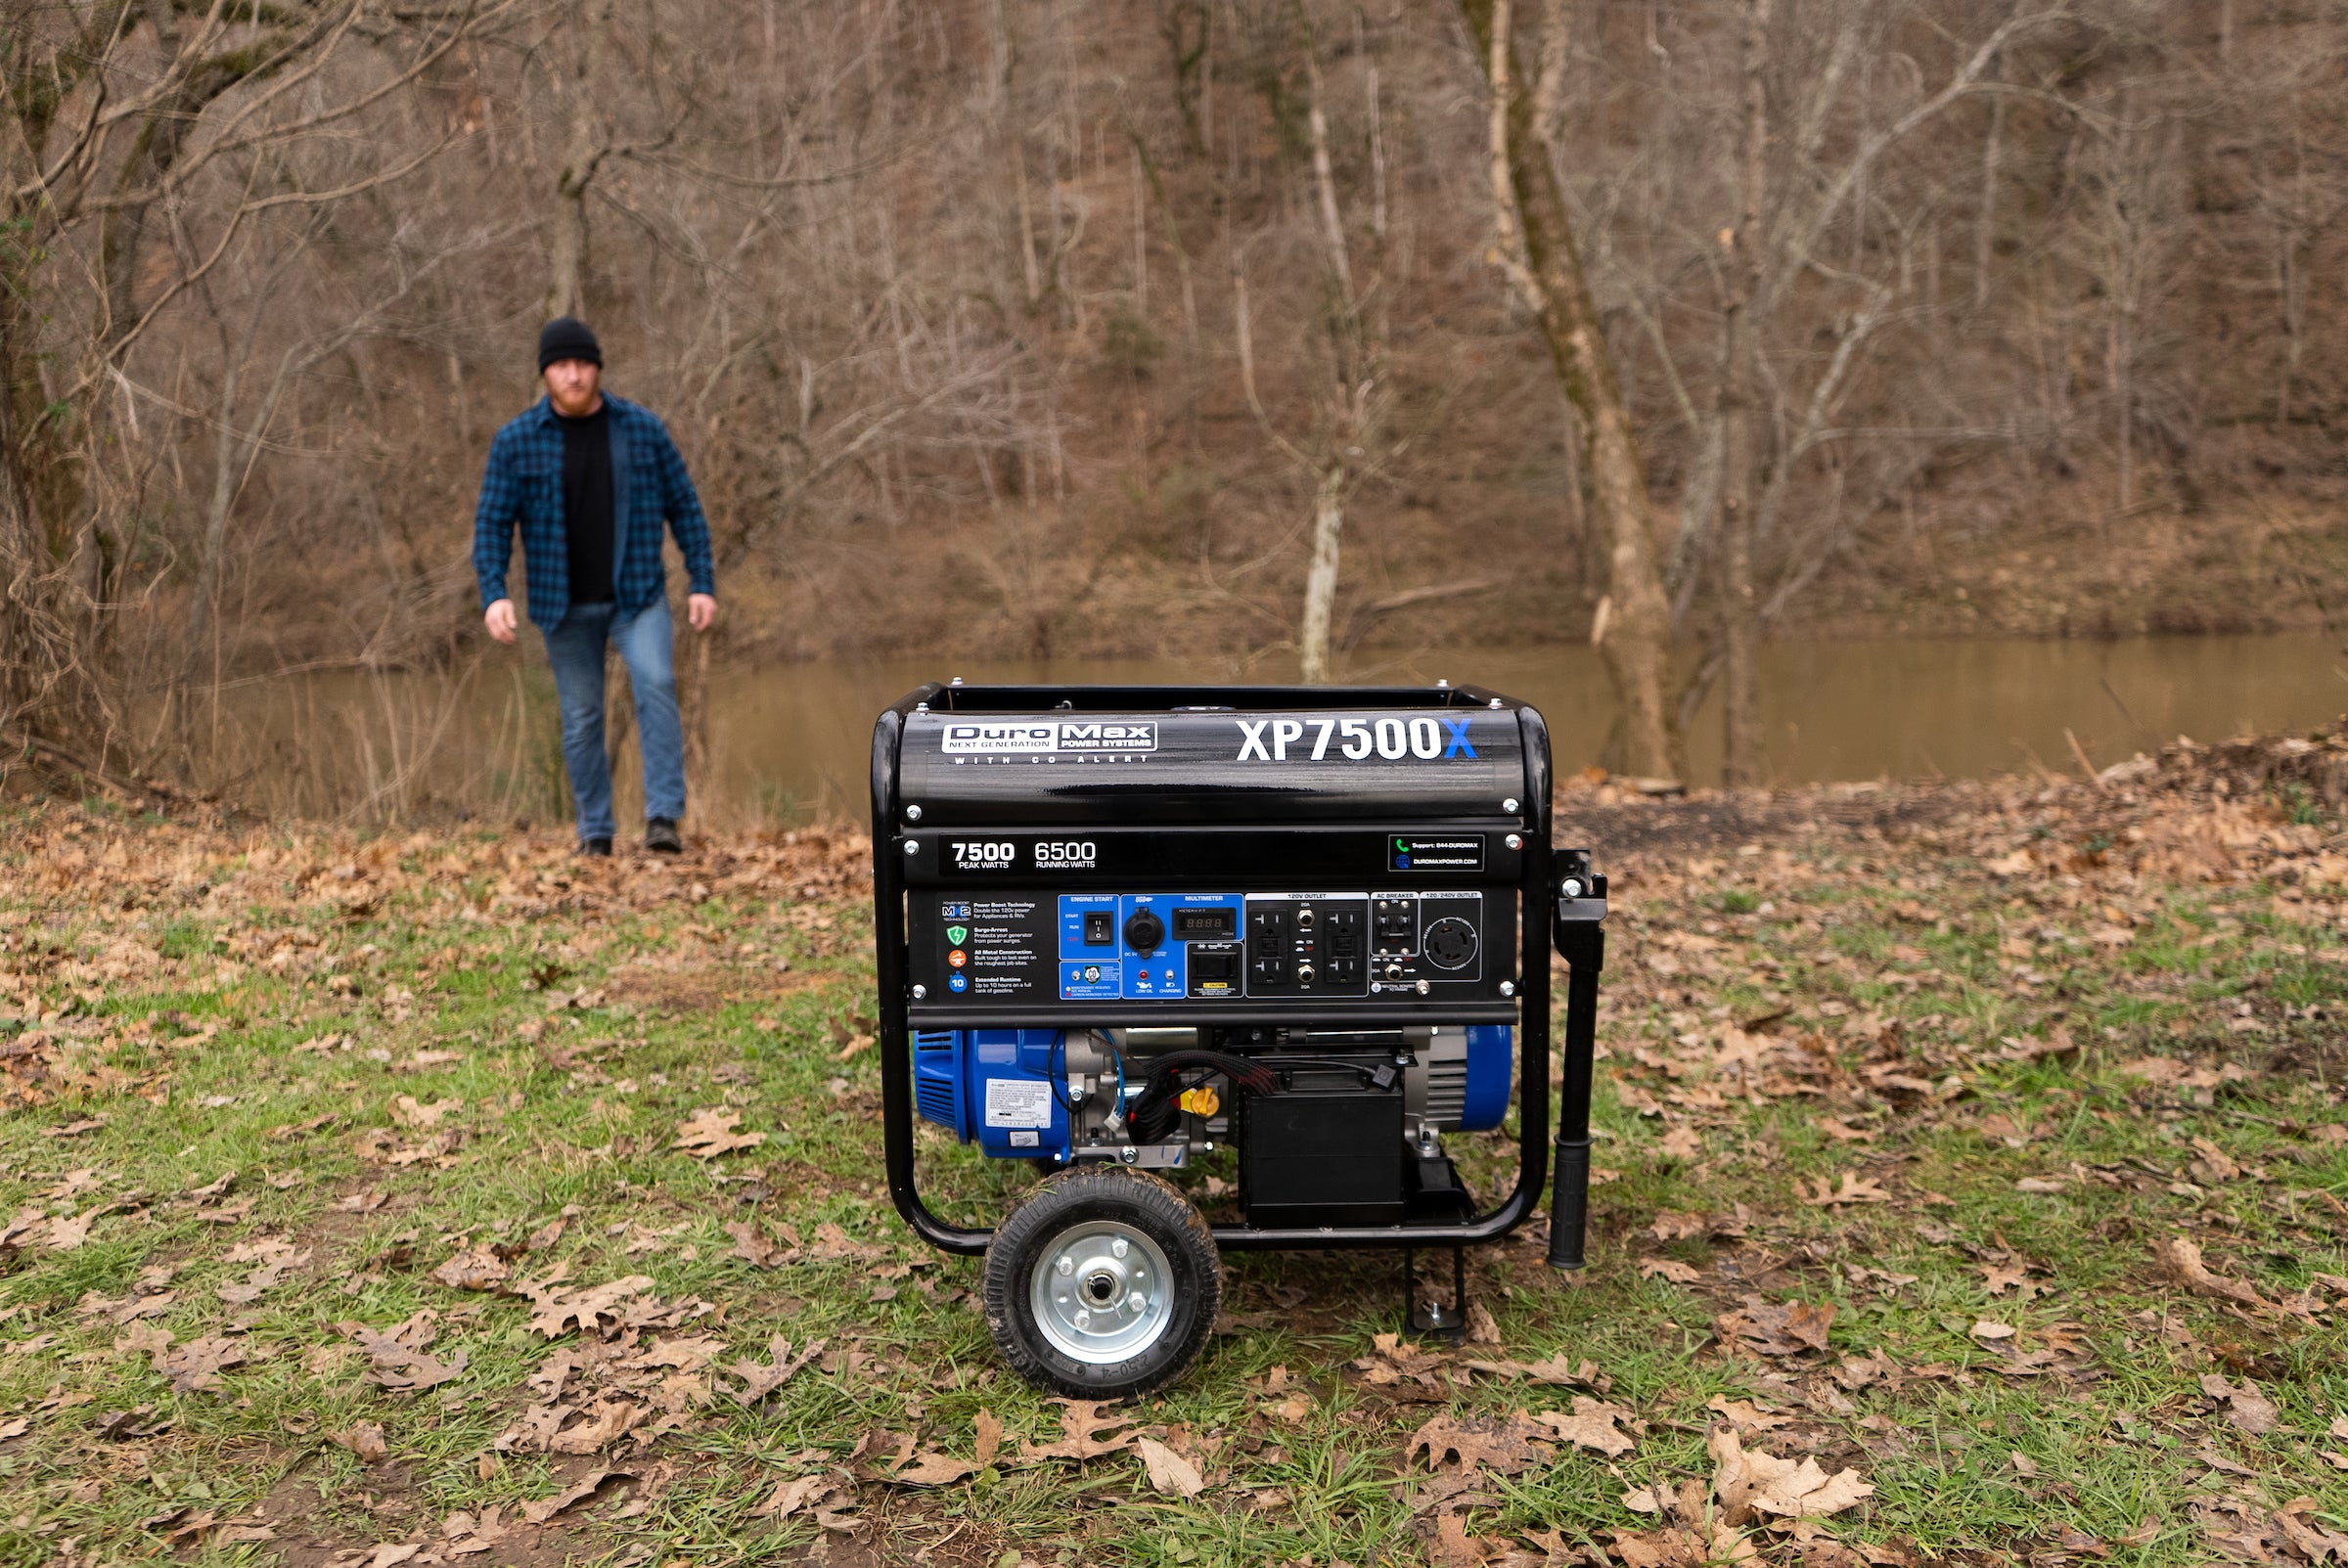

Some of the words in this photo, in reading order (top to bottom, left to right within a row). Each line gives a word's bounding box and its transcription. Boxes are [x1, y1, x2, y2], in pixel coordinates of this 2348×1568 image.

[1235, 718, 1478, 761] XP7500X
[955, 756, 1011, 765] WITH
[1031, 756, 1056, 765] CO
[1077, 755, 1148, 764] ALERT
[952, 842, 1016, 861] 7500
[1034, 842, 1097, 861] 6500
[959, 861, 980, 870] PEAK
[1088, 969, 1096, 978] CO
